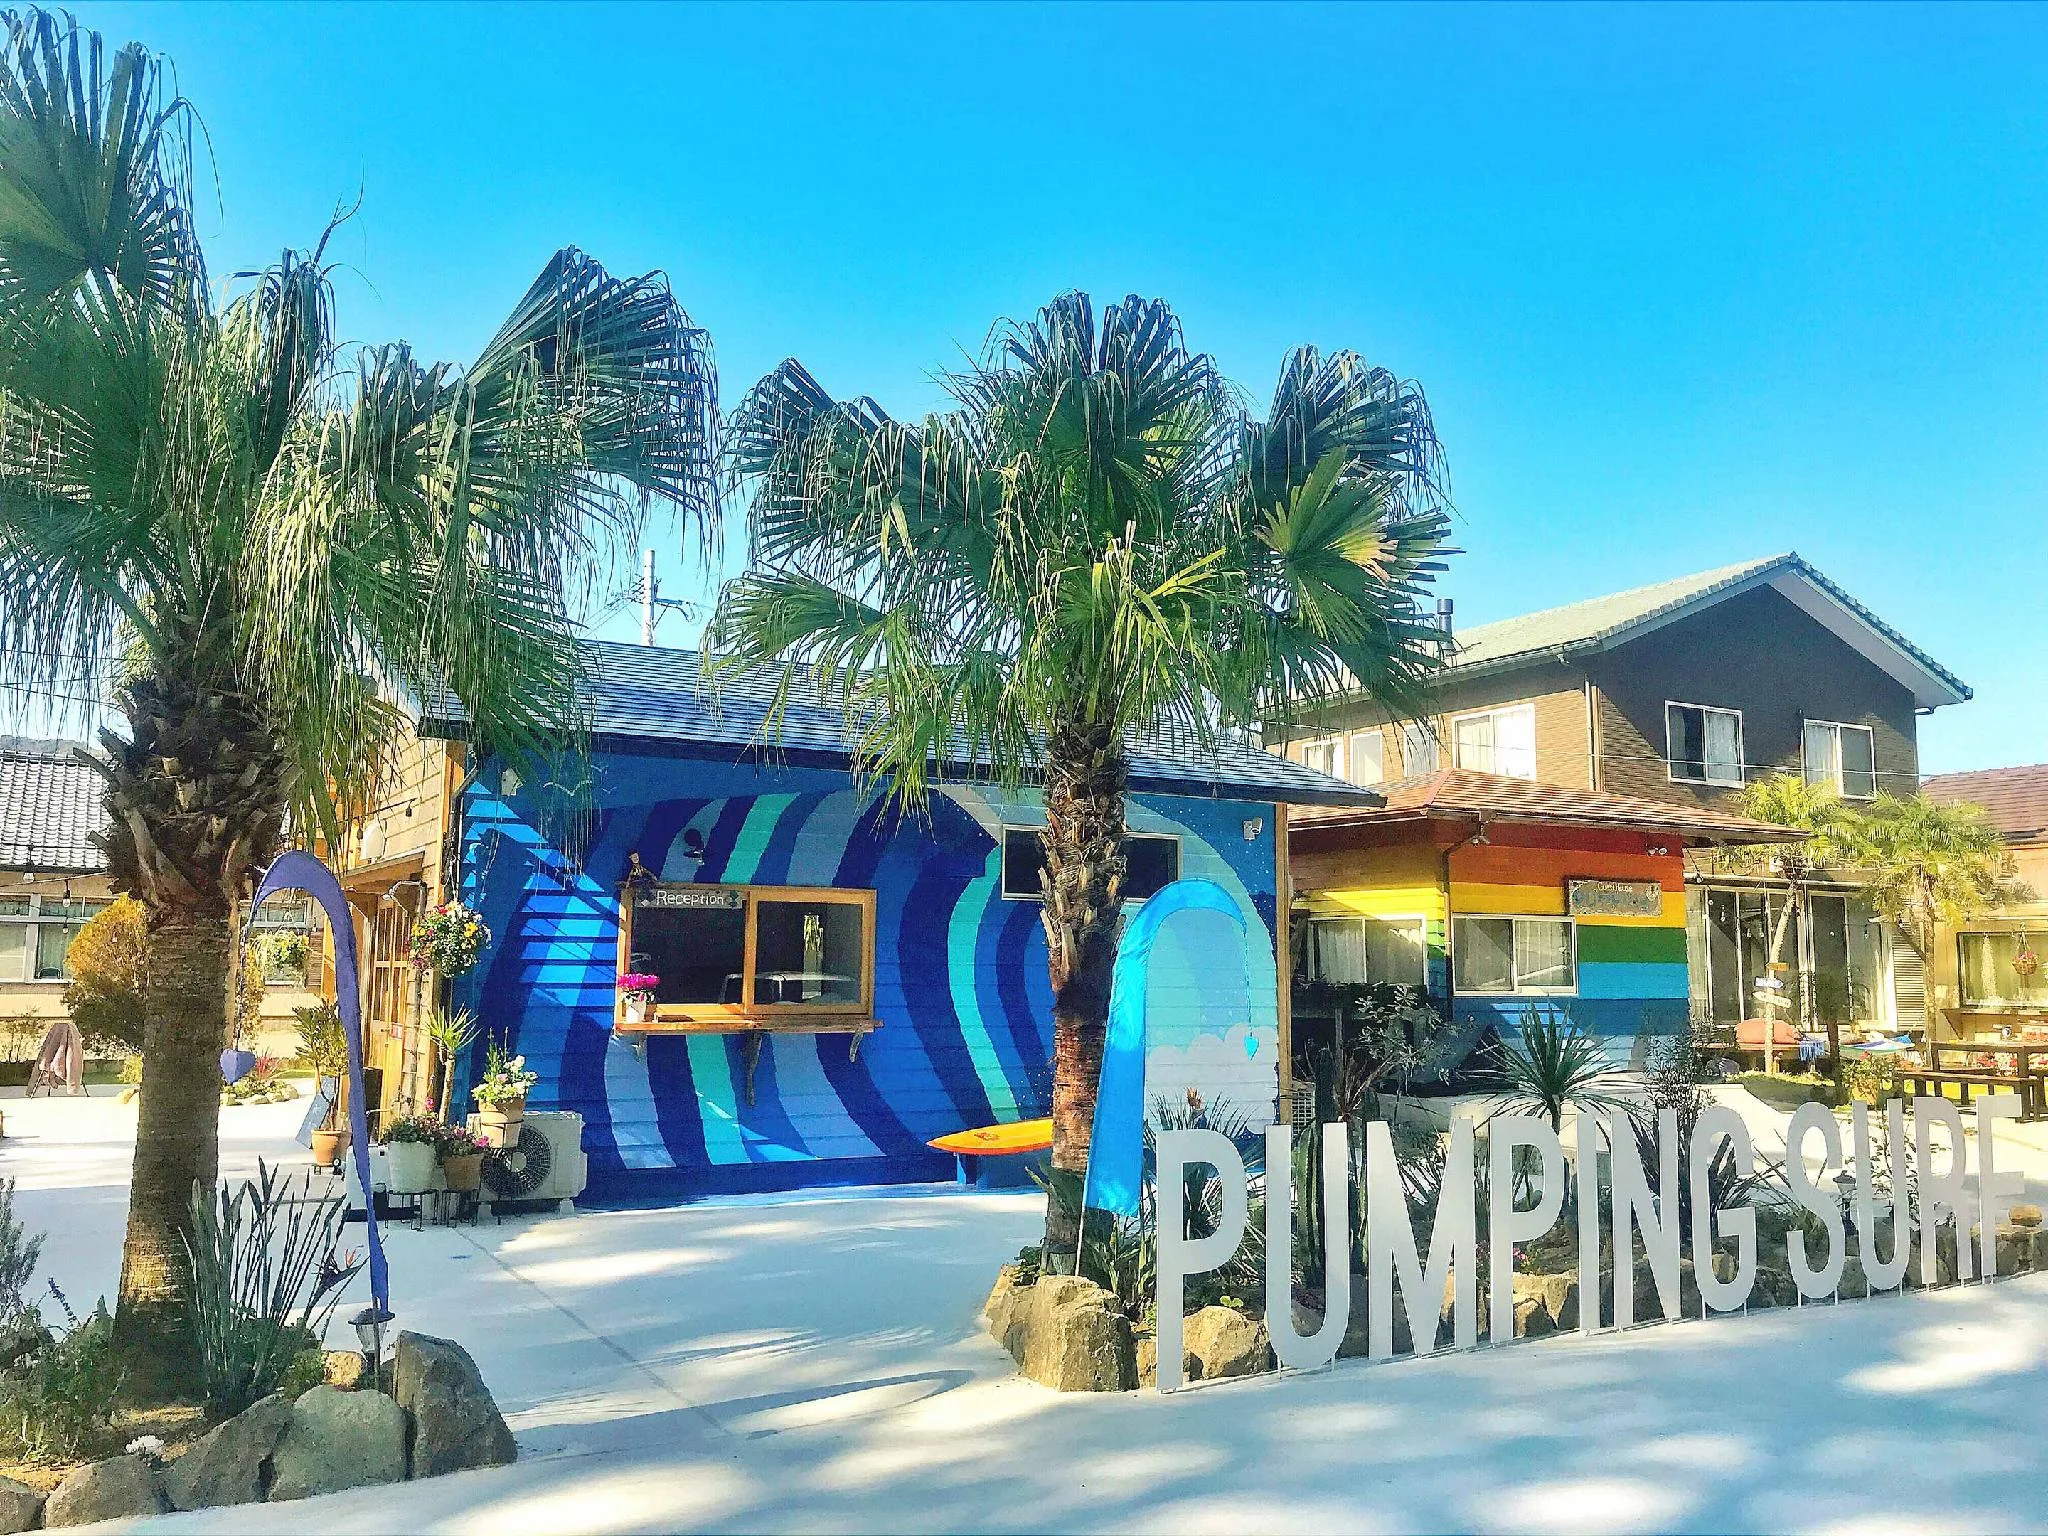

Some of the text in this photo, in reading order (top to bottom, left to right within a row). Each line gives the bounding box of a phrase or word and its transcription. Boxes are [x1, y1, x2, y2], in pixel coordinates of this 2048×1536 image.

[657, 890, 725, 906] Reception
[1156, 1094, 2024, 1391] PUMPING SURF
